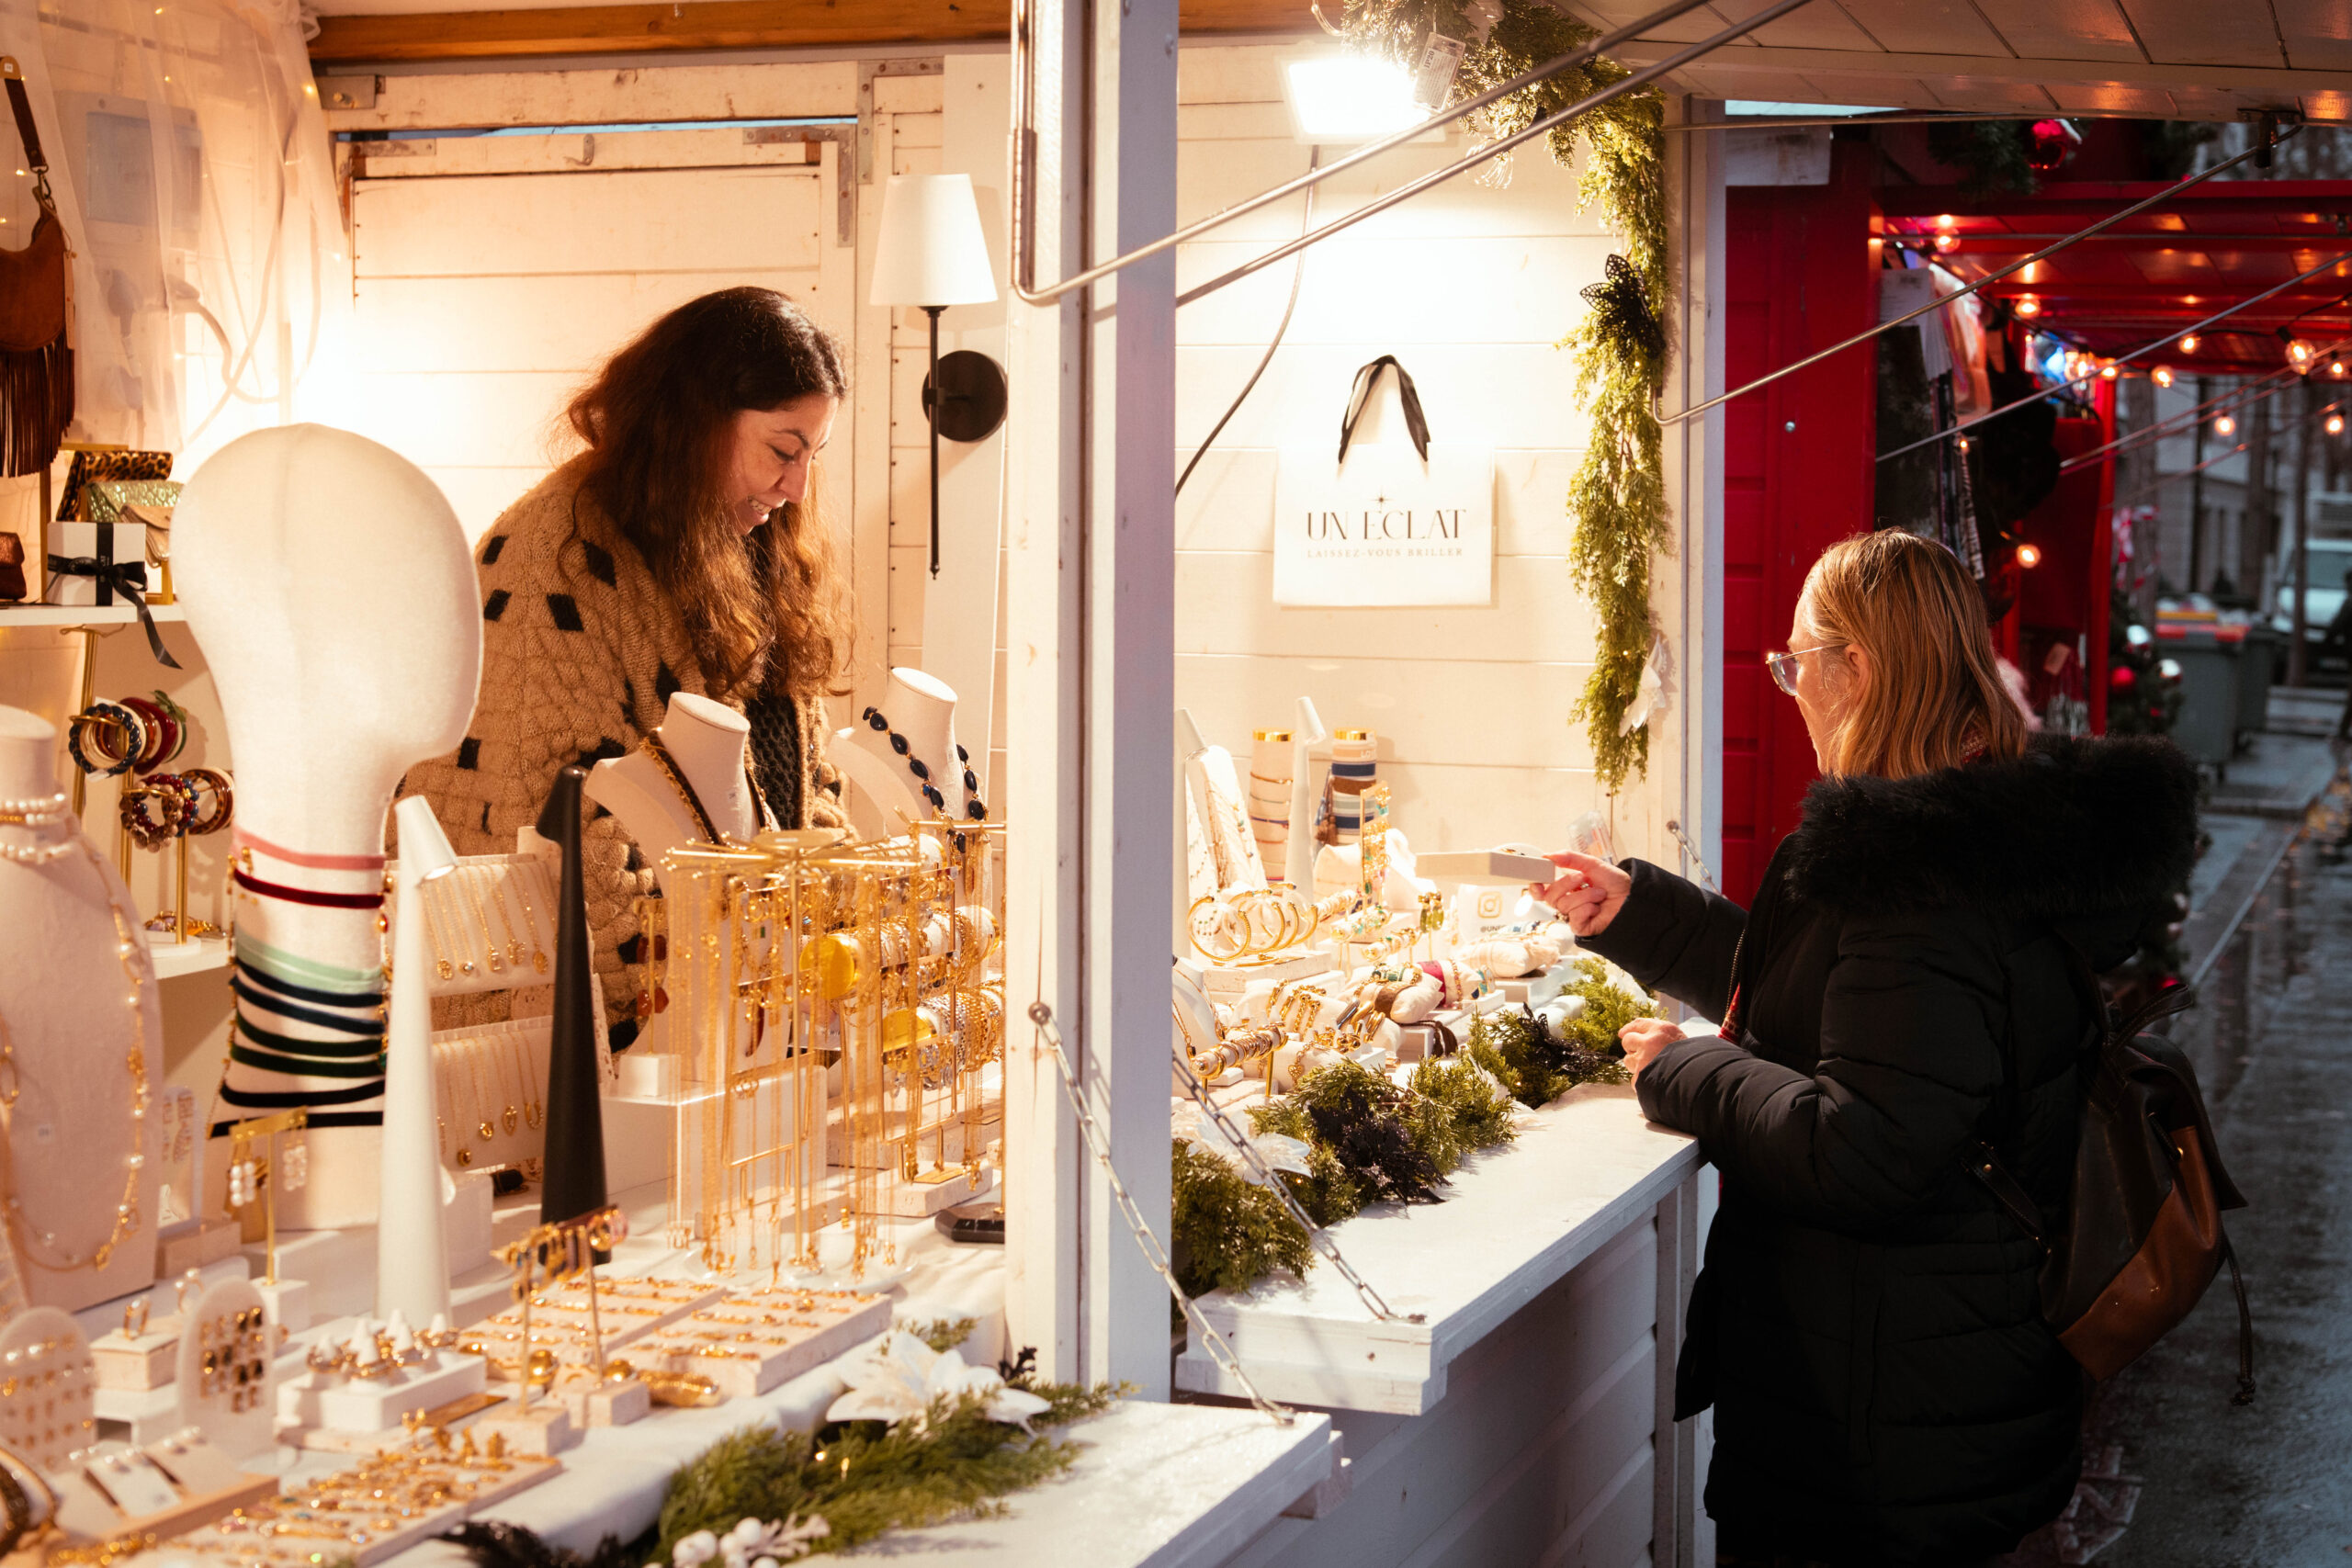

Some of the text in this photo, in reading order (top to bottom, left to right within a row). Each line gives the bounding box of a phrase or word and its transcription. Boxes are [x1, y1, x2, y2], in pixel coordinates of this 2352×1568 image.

[1424, 51, 1435, 69] IP20
[1307, 512, 1349, 541] UN
[1408, 547, 1464, 558] BRILLER
